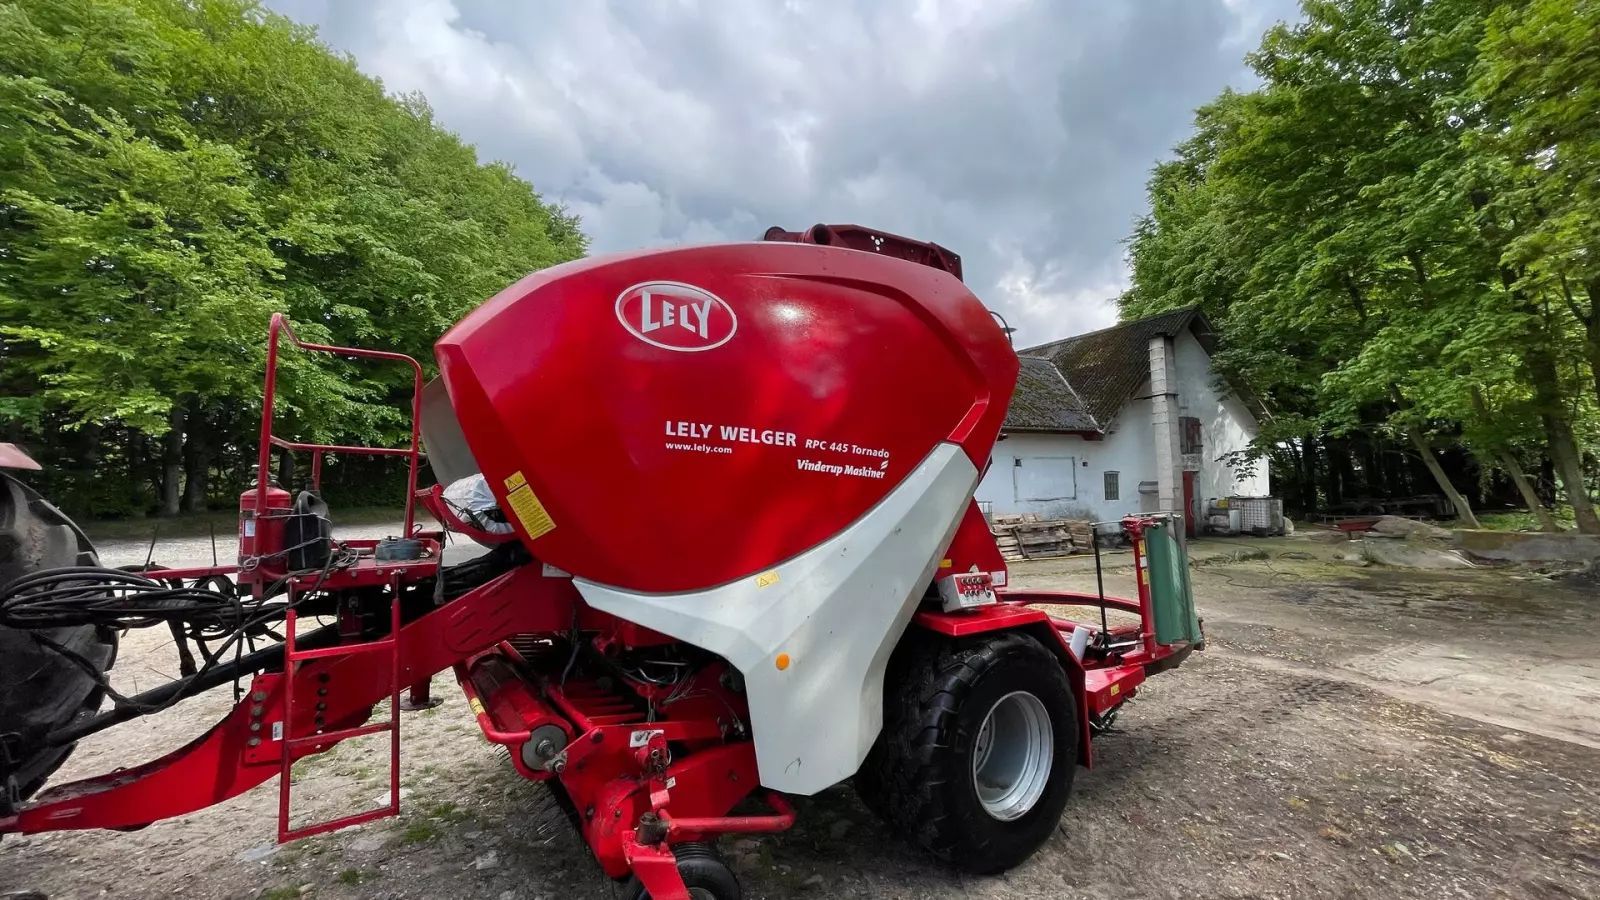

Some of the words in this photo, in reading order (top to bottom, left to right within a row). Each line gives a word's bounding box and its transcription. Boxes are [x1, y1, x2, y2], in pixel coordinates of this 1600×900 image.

[641, 289, 712, 339] LELY
[665, 420, 713, 439] LELY
[720, 425, 797, 447] WELGER
[665, 443, 733, 454] www.lely.com
[805, 438, 827, 450] RPC
[829, 442, 849, 453] 445
[851, 445, 890, 459] Tornado
[797, 459, 843, 475] Vinderup
[843, 464, 886, 479] Maskiner
